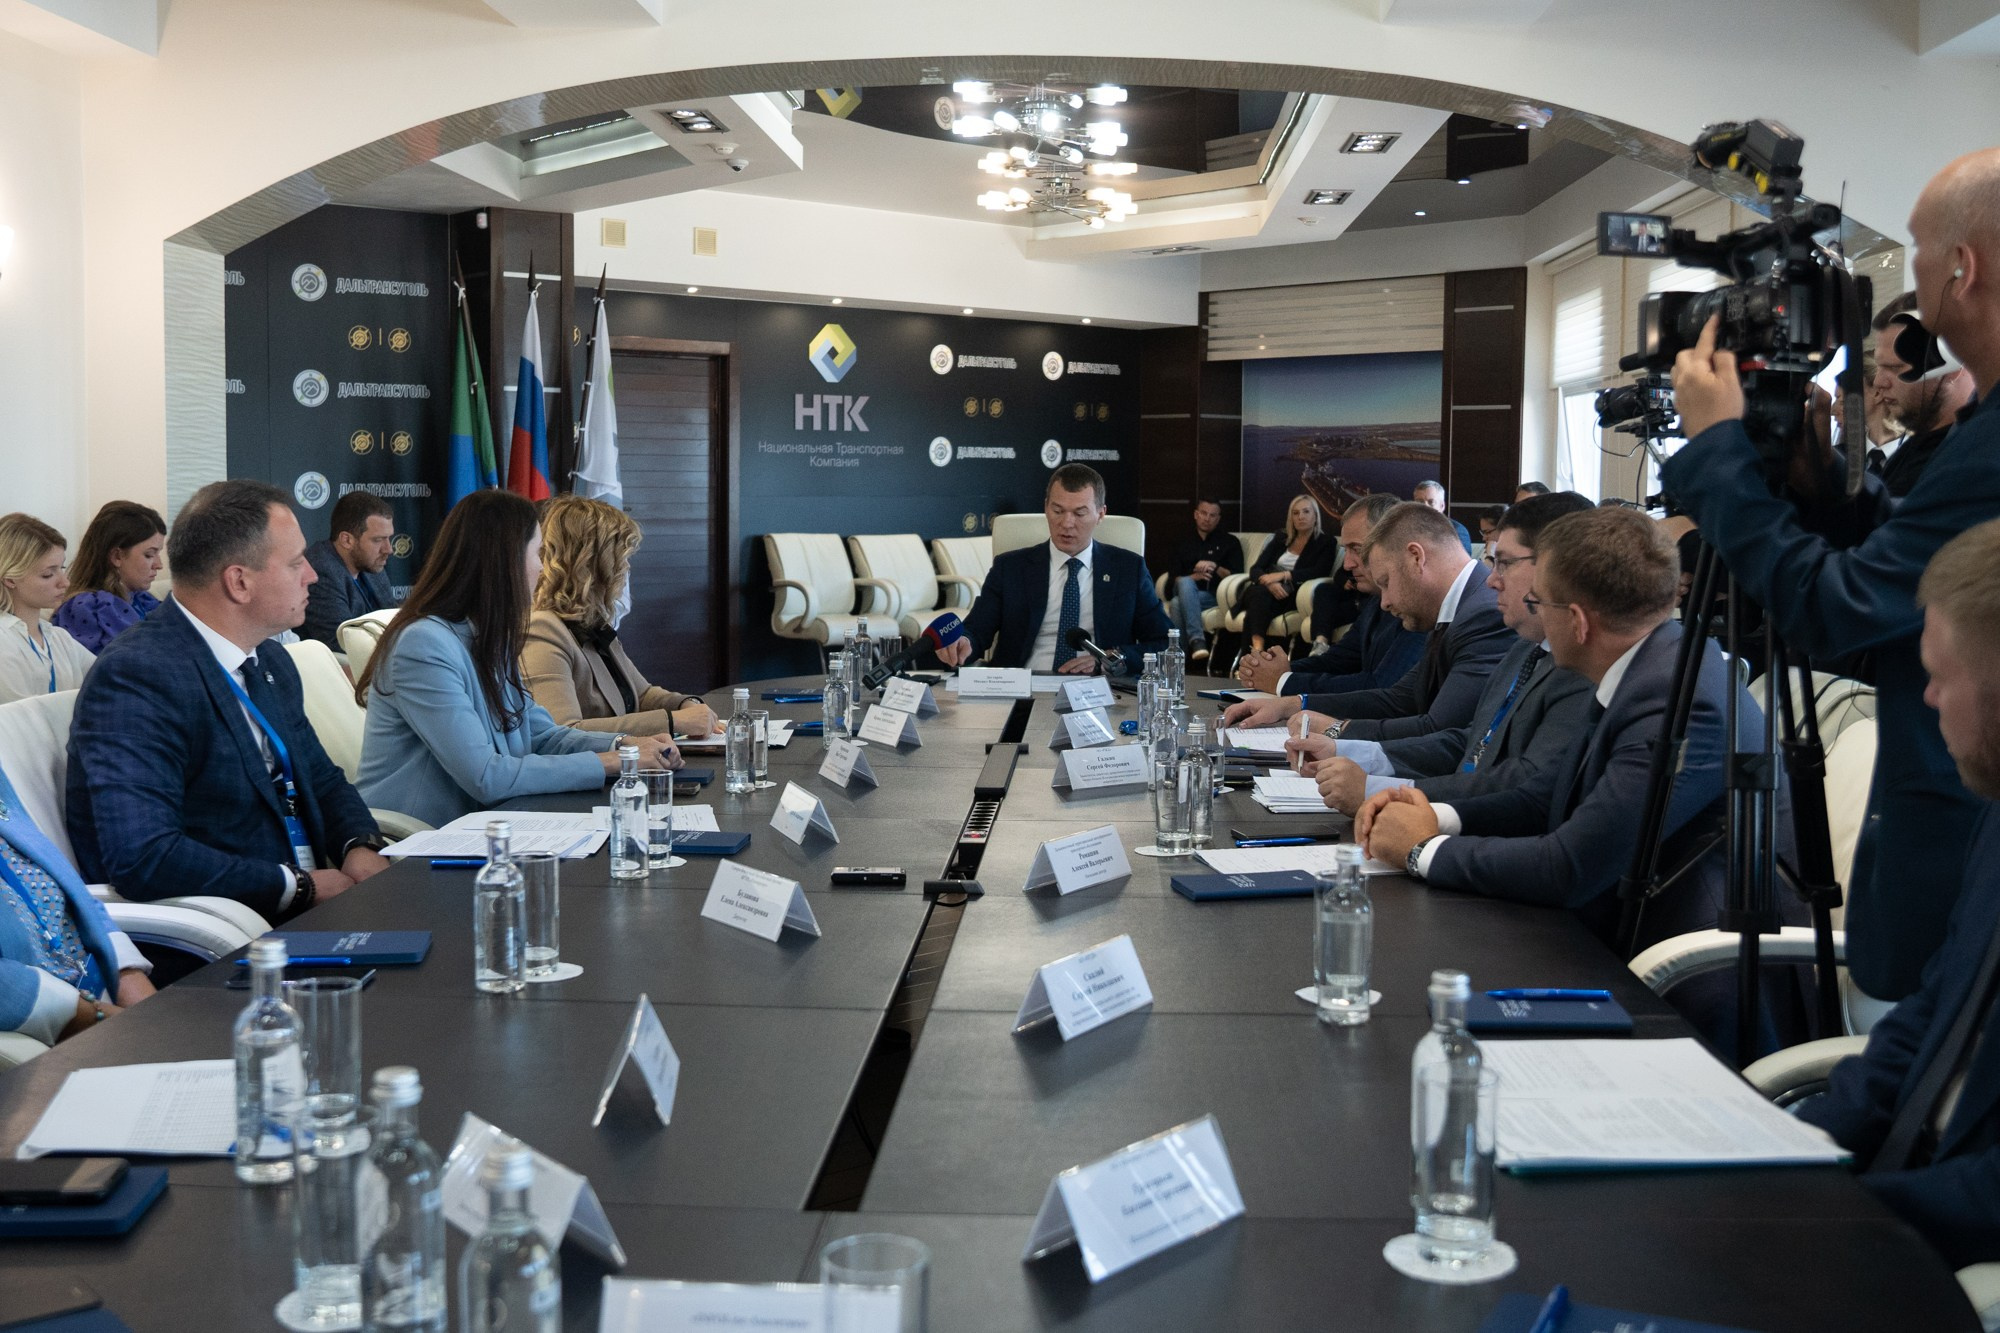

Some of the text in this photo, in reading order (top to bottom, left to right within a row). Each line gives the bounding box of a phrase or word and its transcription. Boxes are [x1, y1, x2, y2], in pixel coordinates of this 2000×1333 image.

[335, 277, 429, 297] ДАЛЬТРАНСУГОЛЬ
[337, 382, 431, 399] ДАЛЬТРАНСУГОЛЬ
[795, 393, 870, 432] НТК
[758, 440, 904, 456] Национальная Транспортная
[809, 456, 860, 468] Компания
